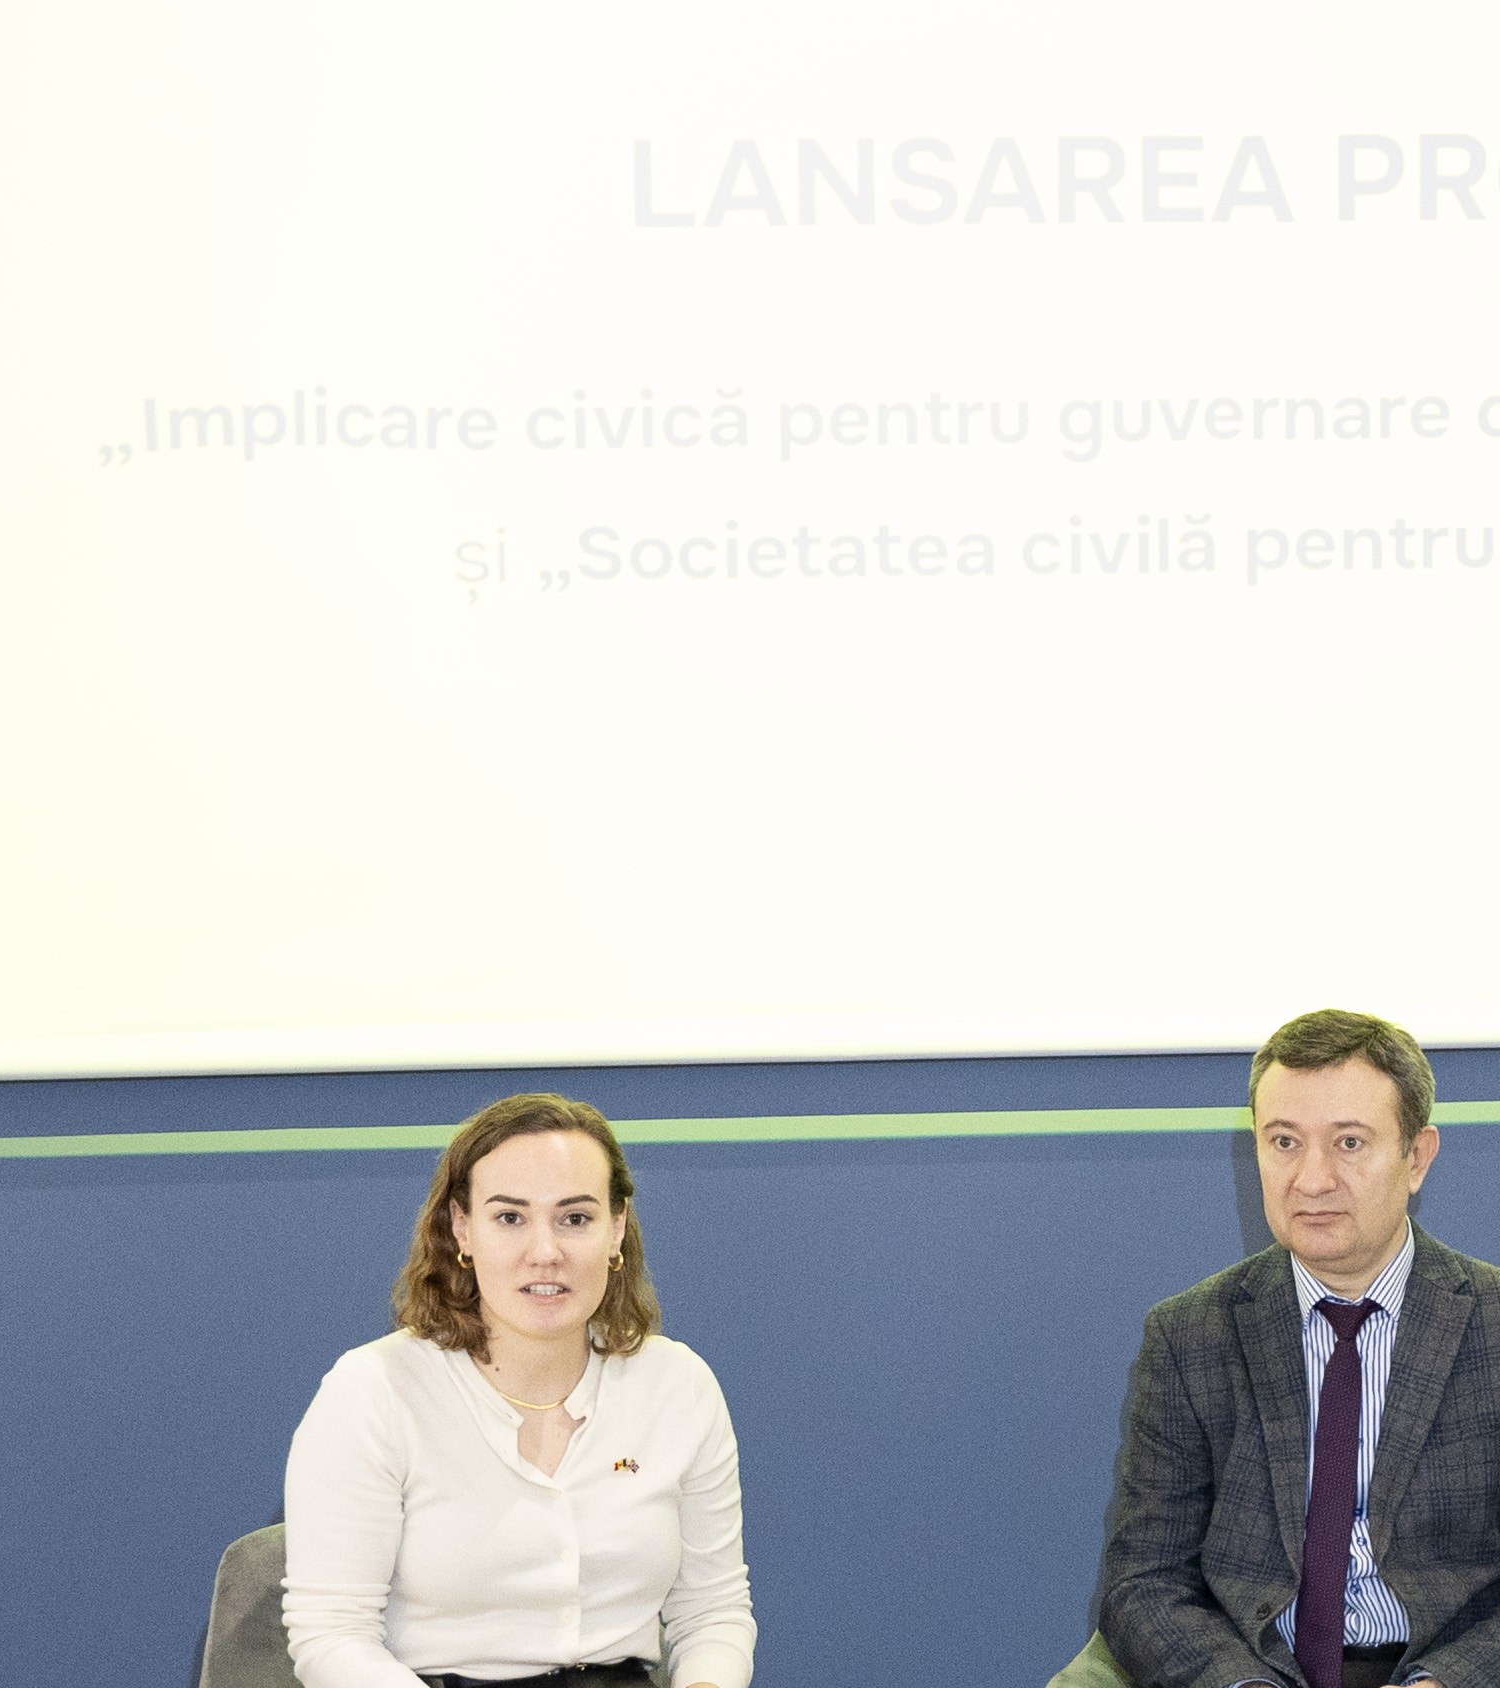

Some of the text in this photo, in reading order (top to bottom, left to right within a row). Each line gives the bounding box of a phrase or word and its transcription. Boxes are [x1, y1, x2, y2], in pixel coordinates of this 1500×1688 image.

[631, 135, 1295, 229] LANSAREA
[525, 387, 751, 450] civică
[778, 392, 1031, 460] pentru
[1058, 391, 1450, 461] guvernare
[454, 528, 509, 603] și
[1021, 514, 1218, 576] civilă
[1246, 515, 1495, 583] pentru
